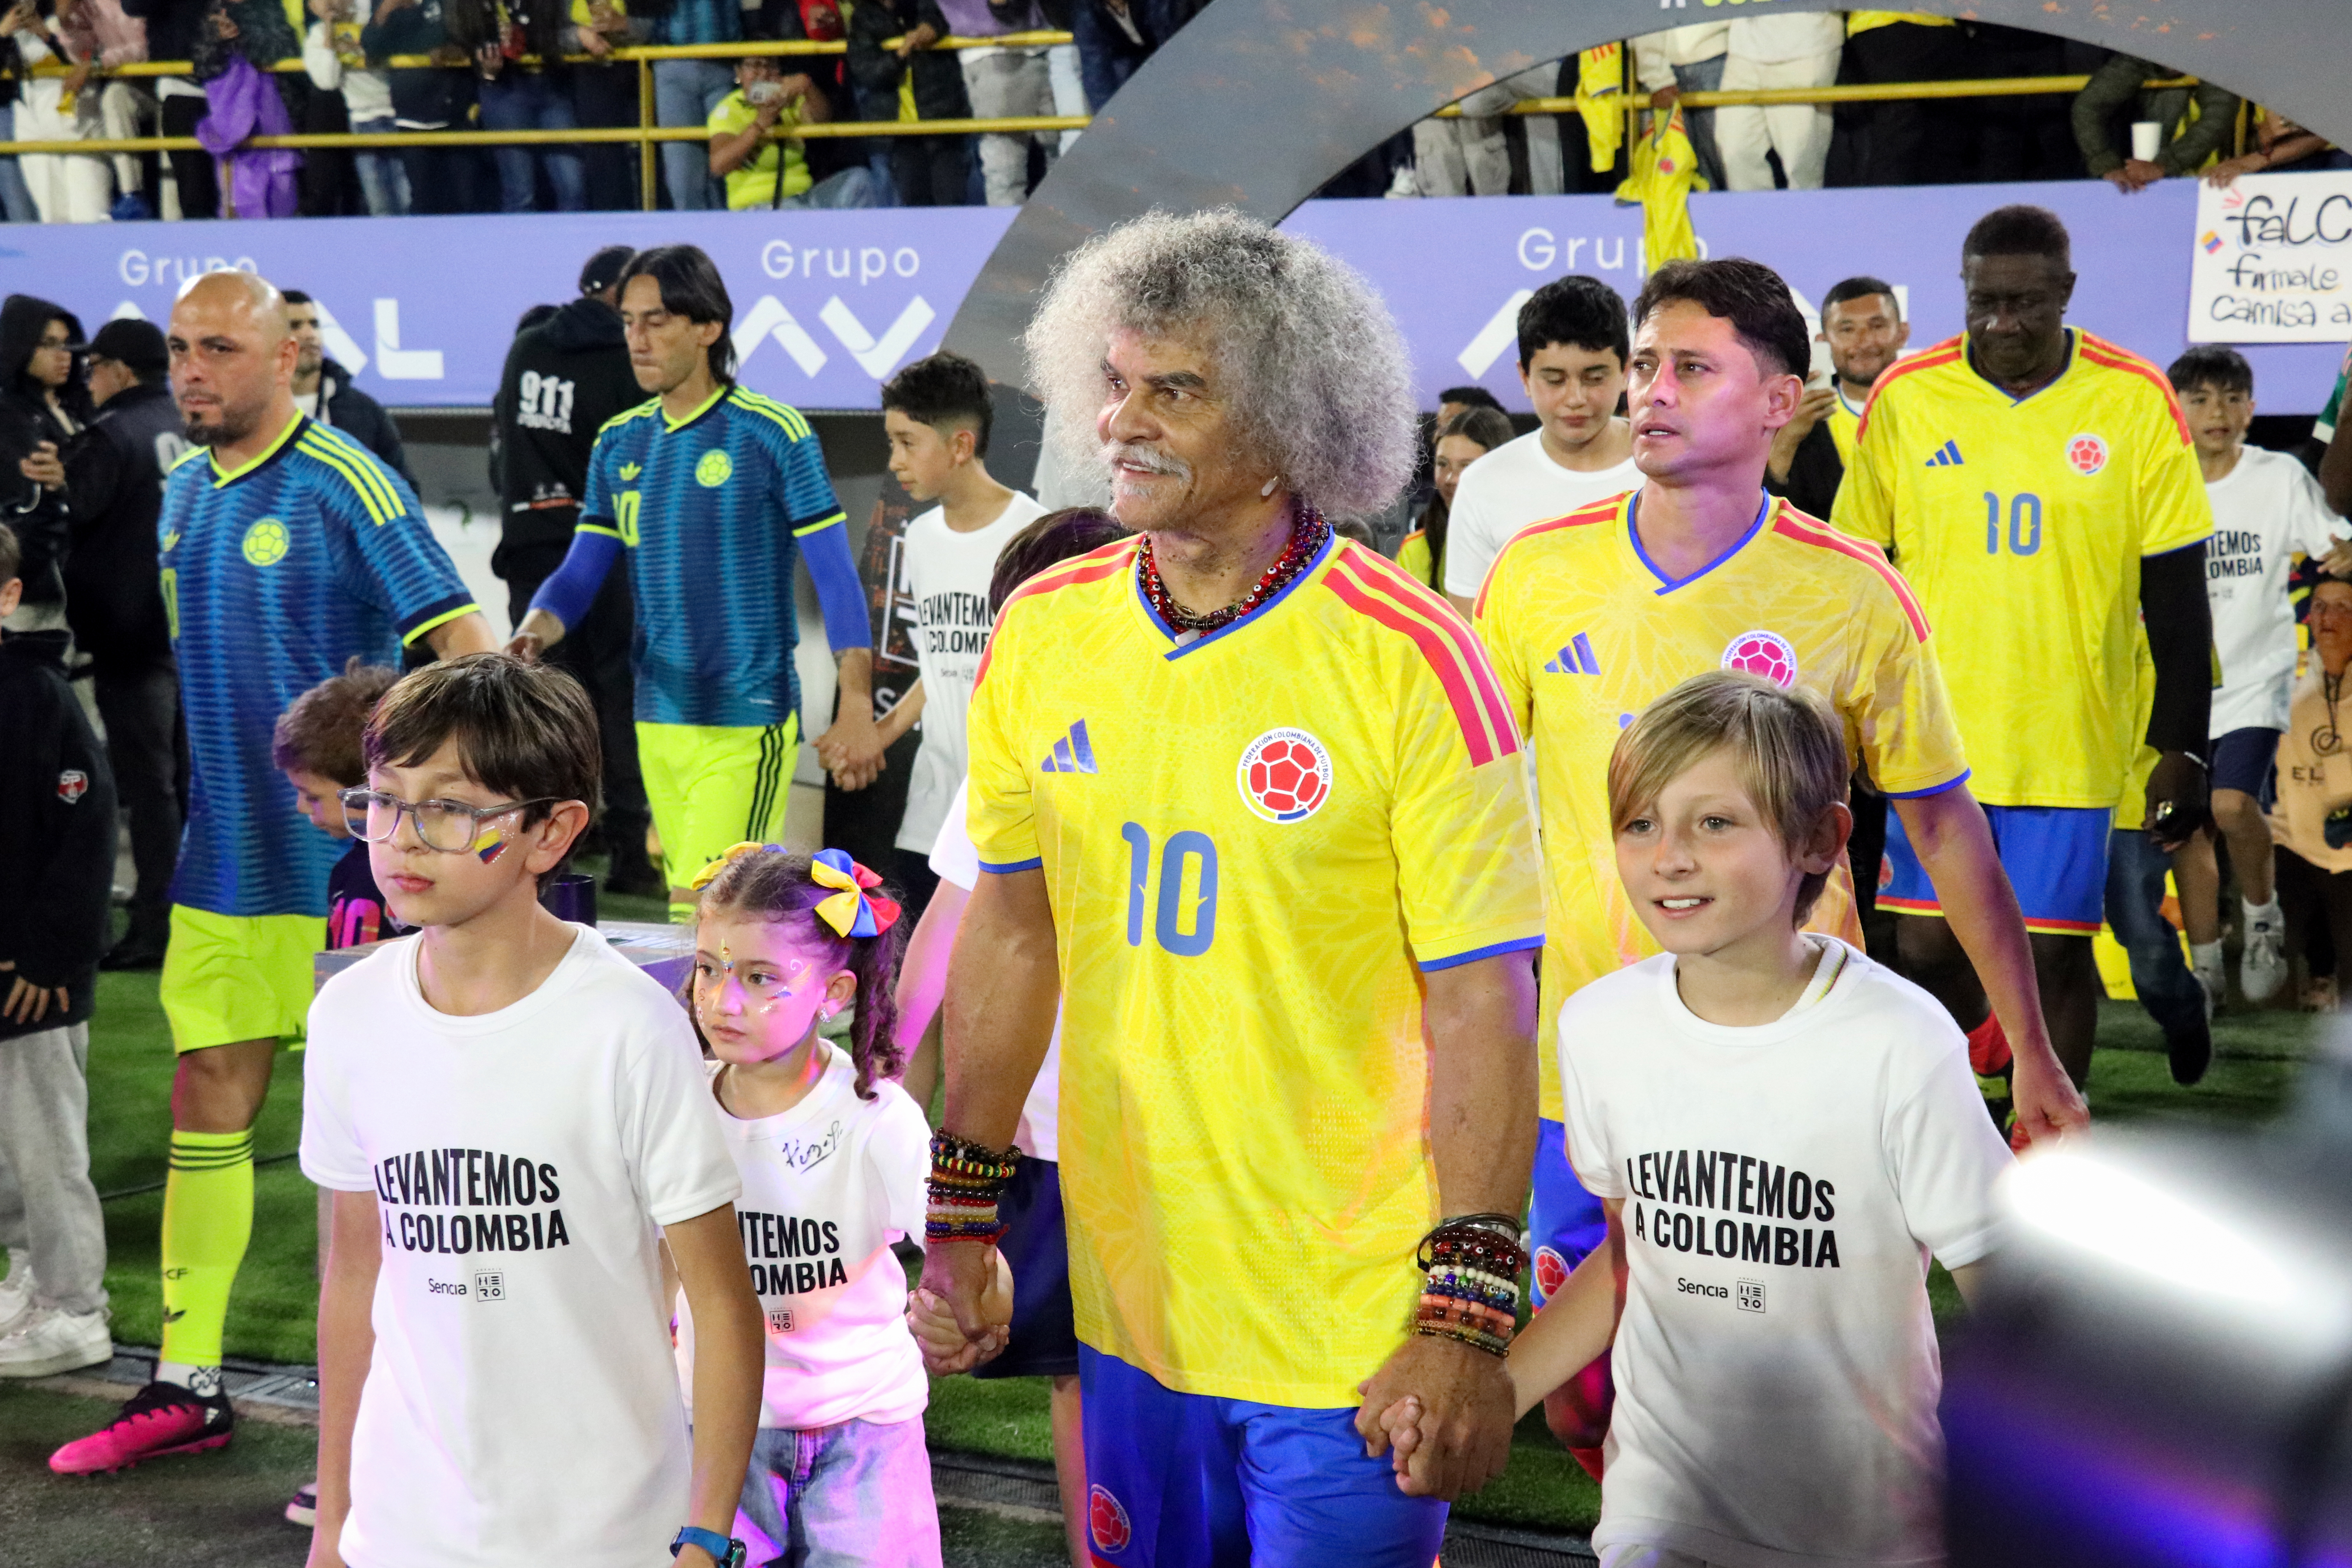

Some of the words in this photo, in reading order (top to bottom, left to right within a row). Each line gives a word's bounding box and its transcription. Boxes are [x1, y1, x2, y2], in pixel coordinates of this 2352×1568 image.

[762, 239, 920, 286] Grupo
[519, 370, 575, 421] 911
[1984, 491, 2041, 556] 10
[2207, 531, 2261, 558] TEMOS
[2208, 557, 2263, 579] OMBIA
[1274, 731, 1315, 749] COLOMBIANA
[1314, 746, 1322, 755] DE
[1122, 821, 1218, 956] 10
[374, 1149, 560, 1206] LEVANTEMOS
[1627, 1150, 1835, 1222] LEVANTEMOS
[385, 1209, 396, 1248] A
[400, 1209, 570, 1255] COLOMBIA
[1636, 1201, 1647, 1241] A
[1654, 1209, 1840, 1268] COLOMBIA
[428, 1278, 467, 1295] Sencia
[750, 1258, 848, 1295] OMBIA
[1677, 1277, 1728, 1298] Sencia
